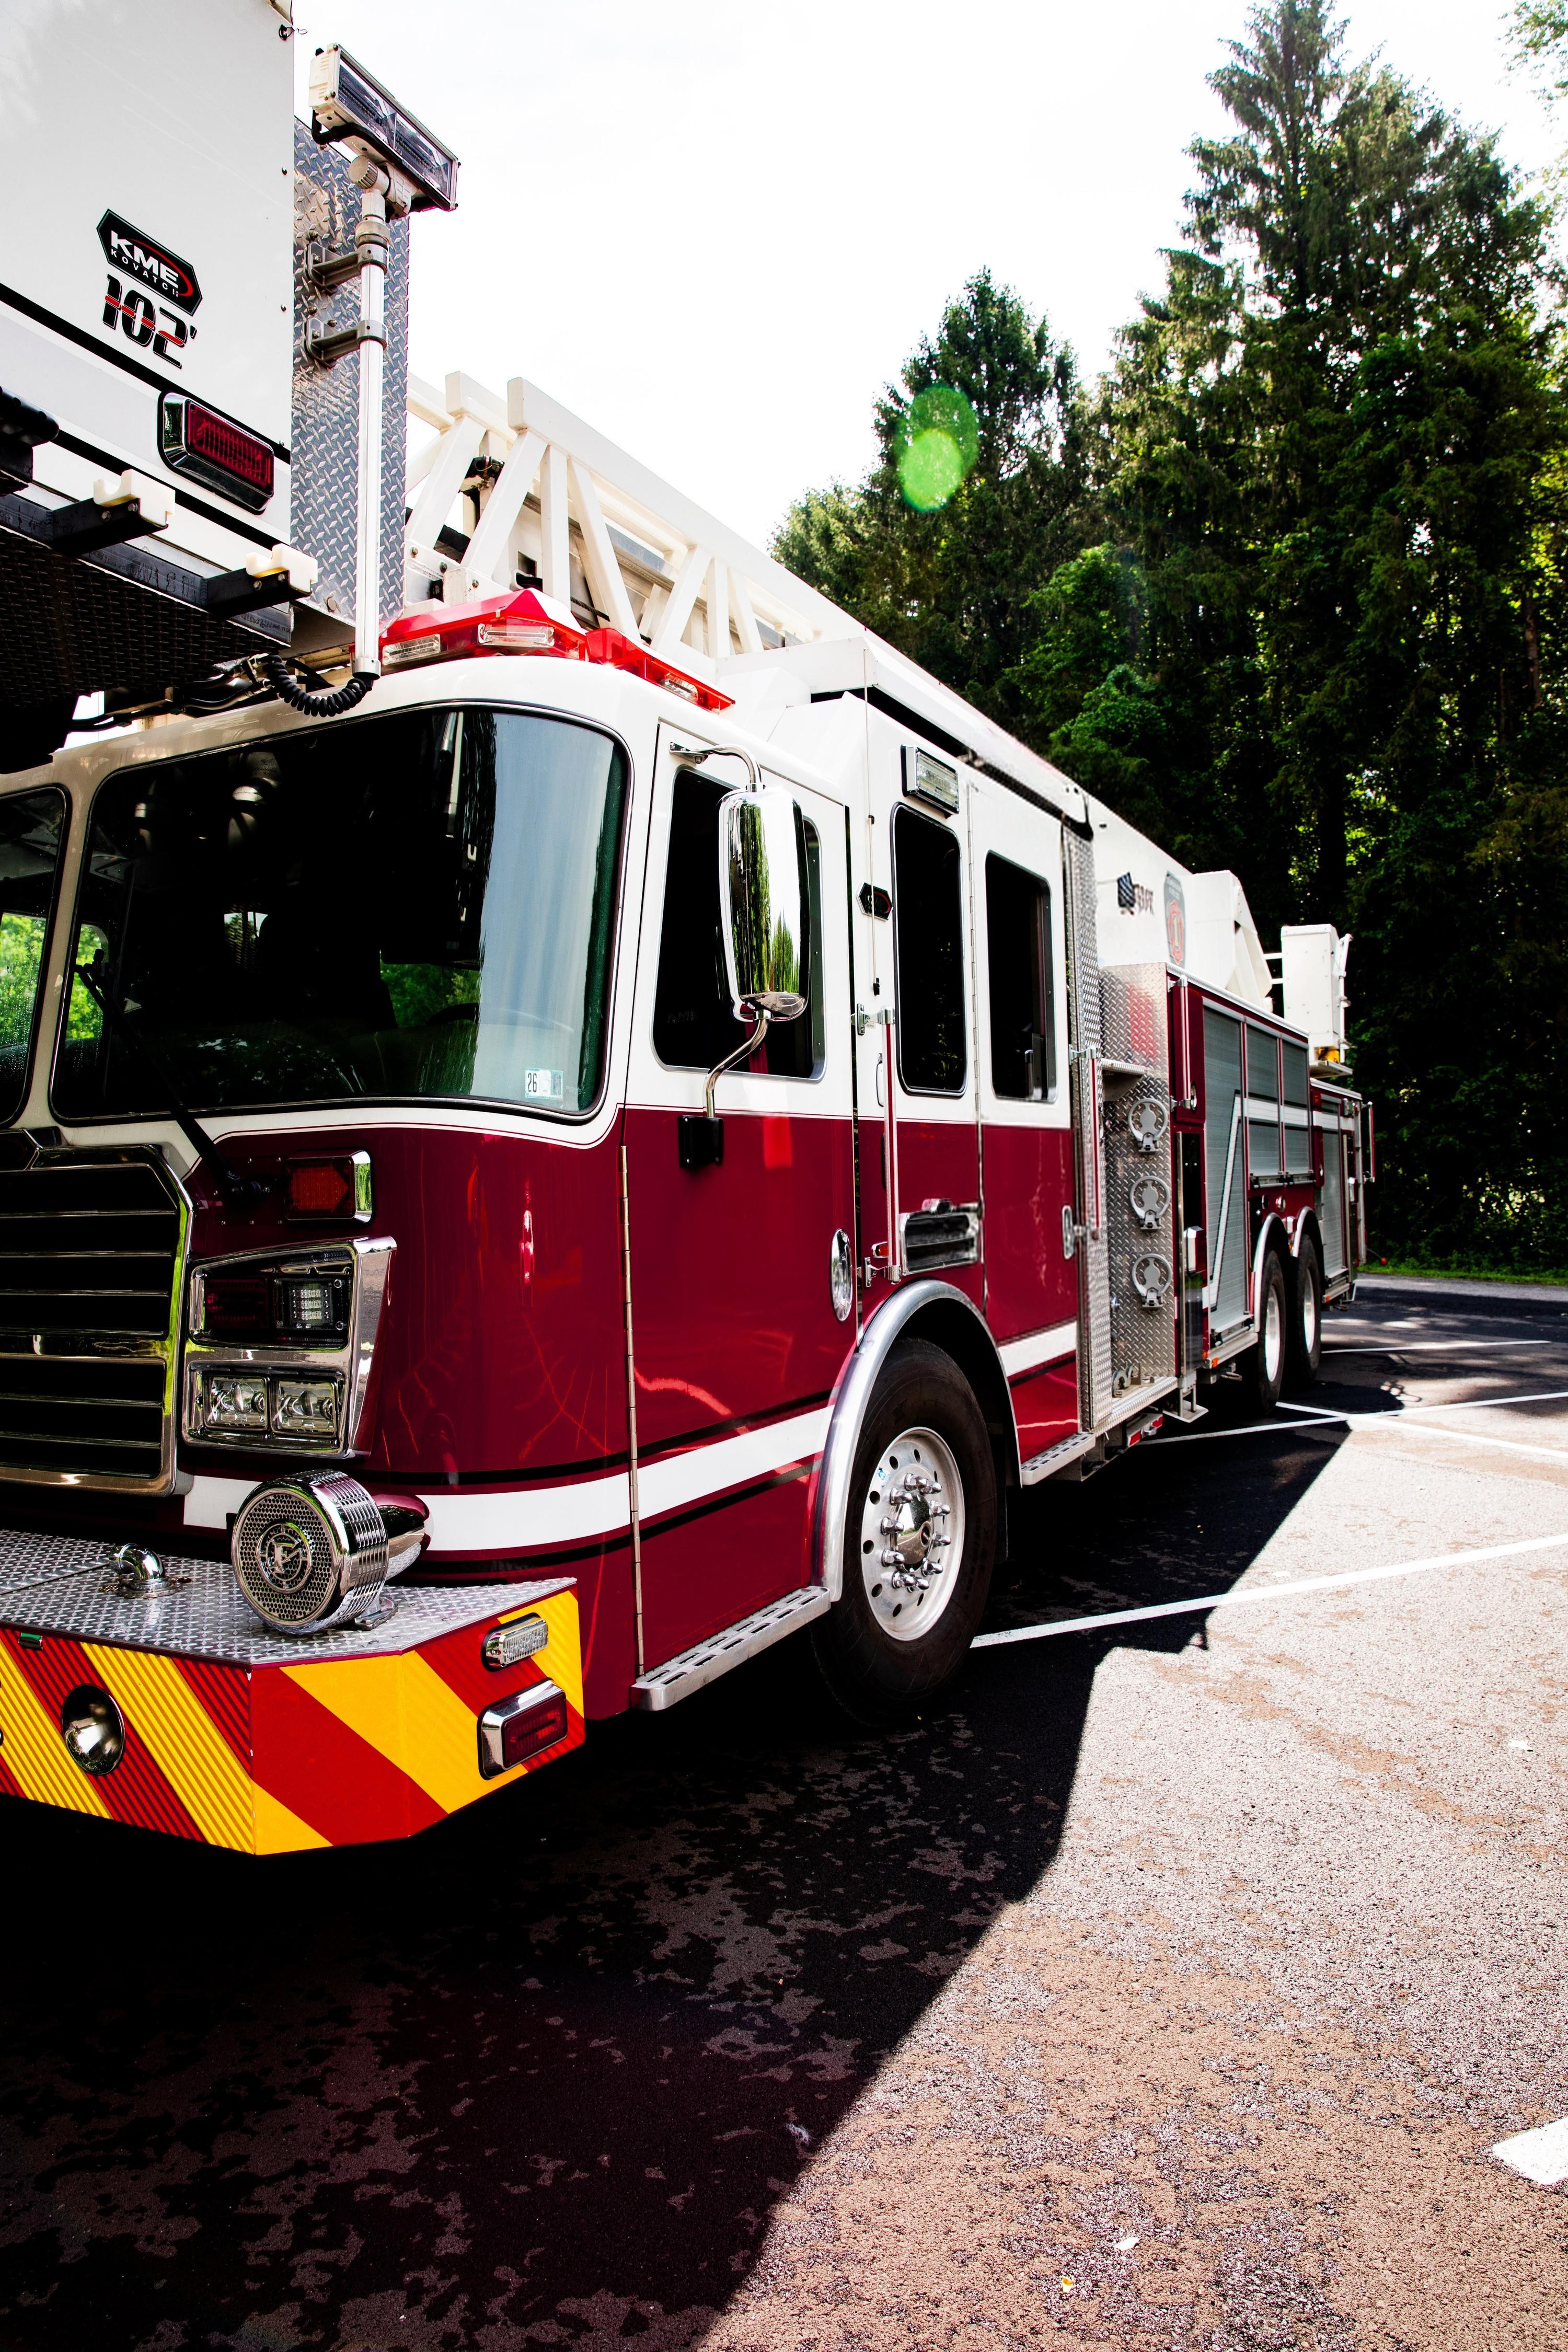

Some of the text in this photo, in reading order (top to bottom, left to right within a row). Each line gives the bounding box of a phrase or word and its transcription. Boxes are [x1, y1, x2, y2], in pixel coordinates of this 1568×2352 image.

[111, 230, 178, 289] KME
[111, 248, 178, 297] KOVATCH
[527, 1073, 537, 1092] 26
